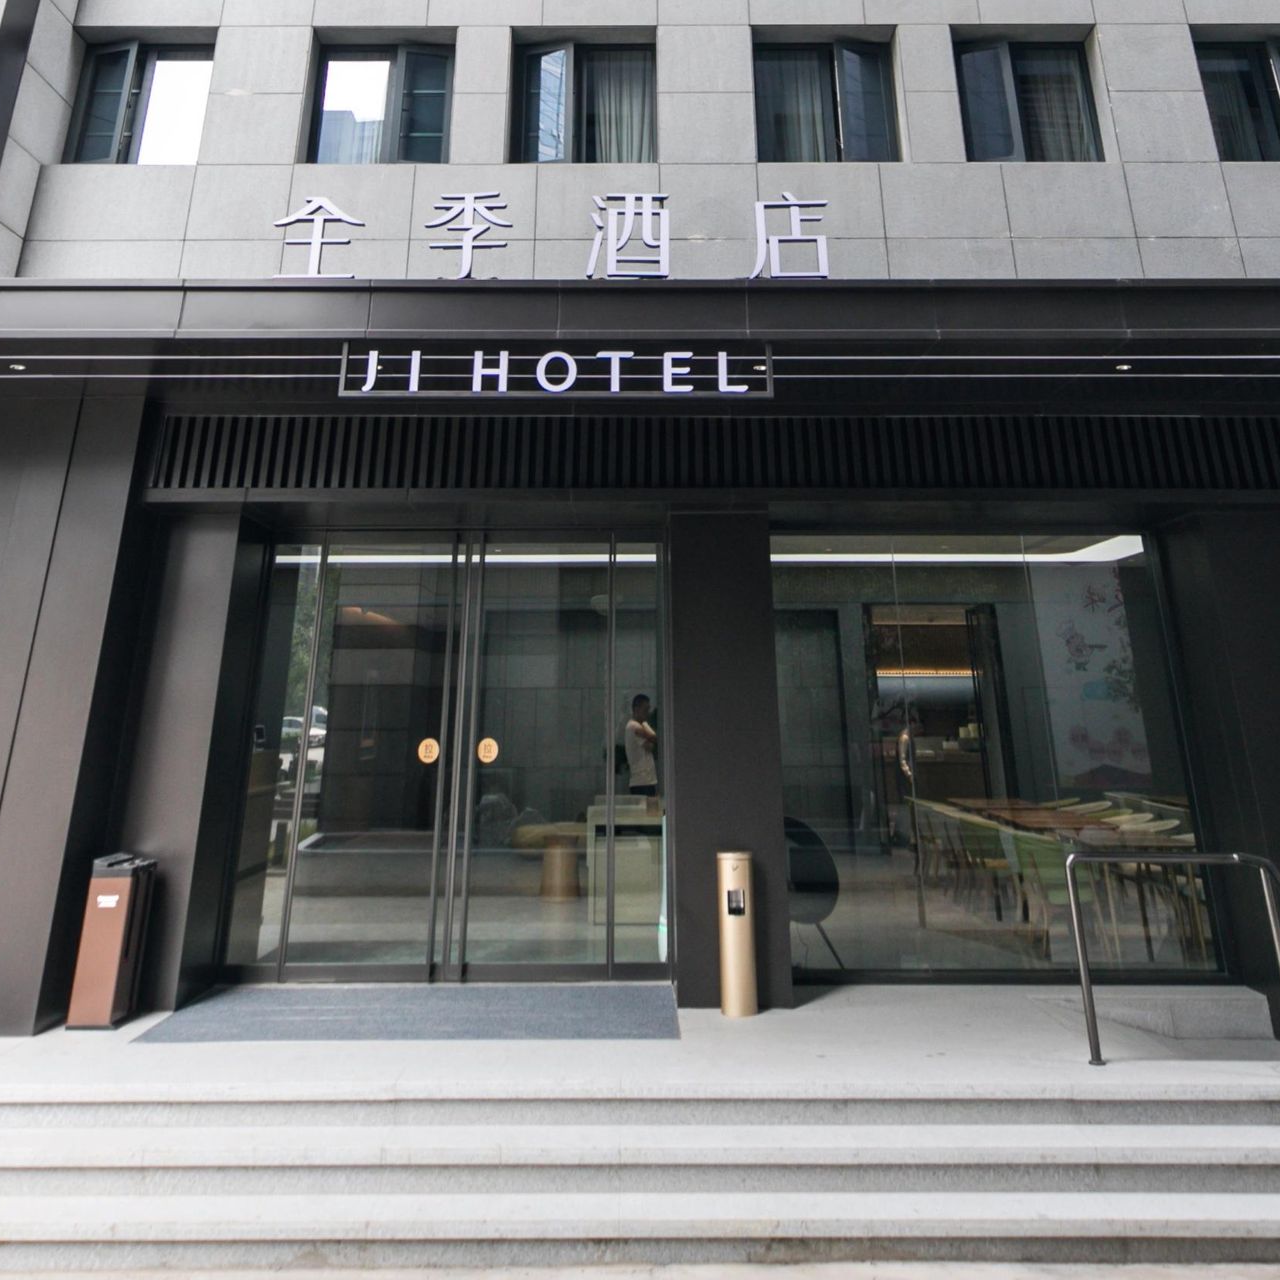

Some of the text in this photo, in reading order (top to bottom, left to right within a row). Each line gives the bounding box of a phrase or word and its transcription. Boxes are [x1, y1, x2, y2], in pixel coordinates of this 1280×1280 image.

[273, 191, 829, 279] 全季酒店
[361, 350, 750, 394] JI HOTEL
